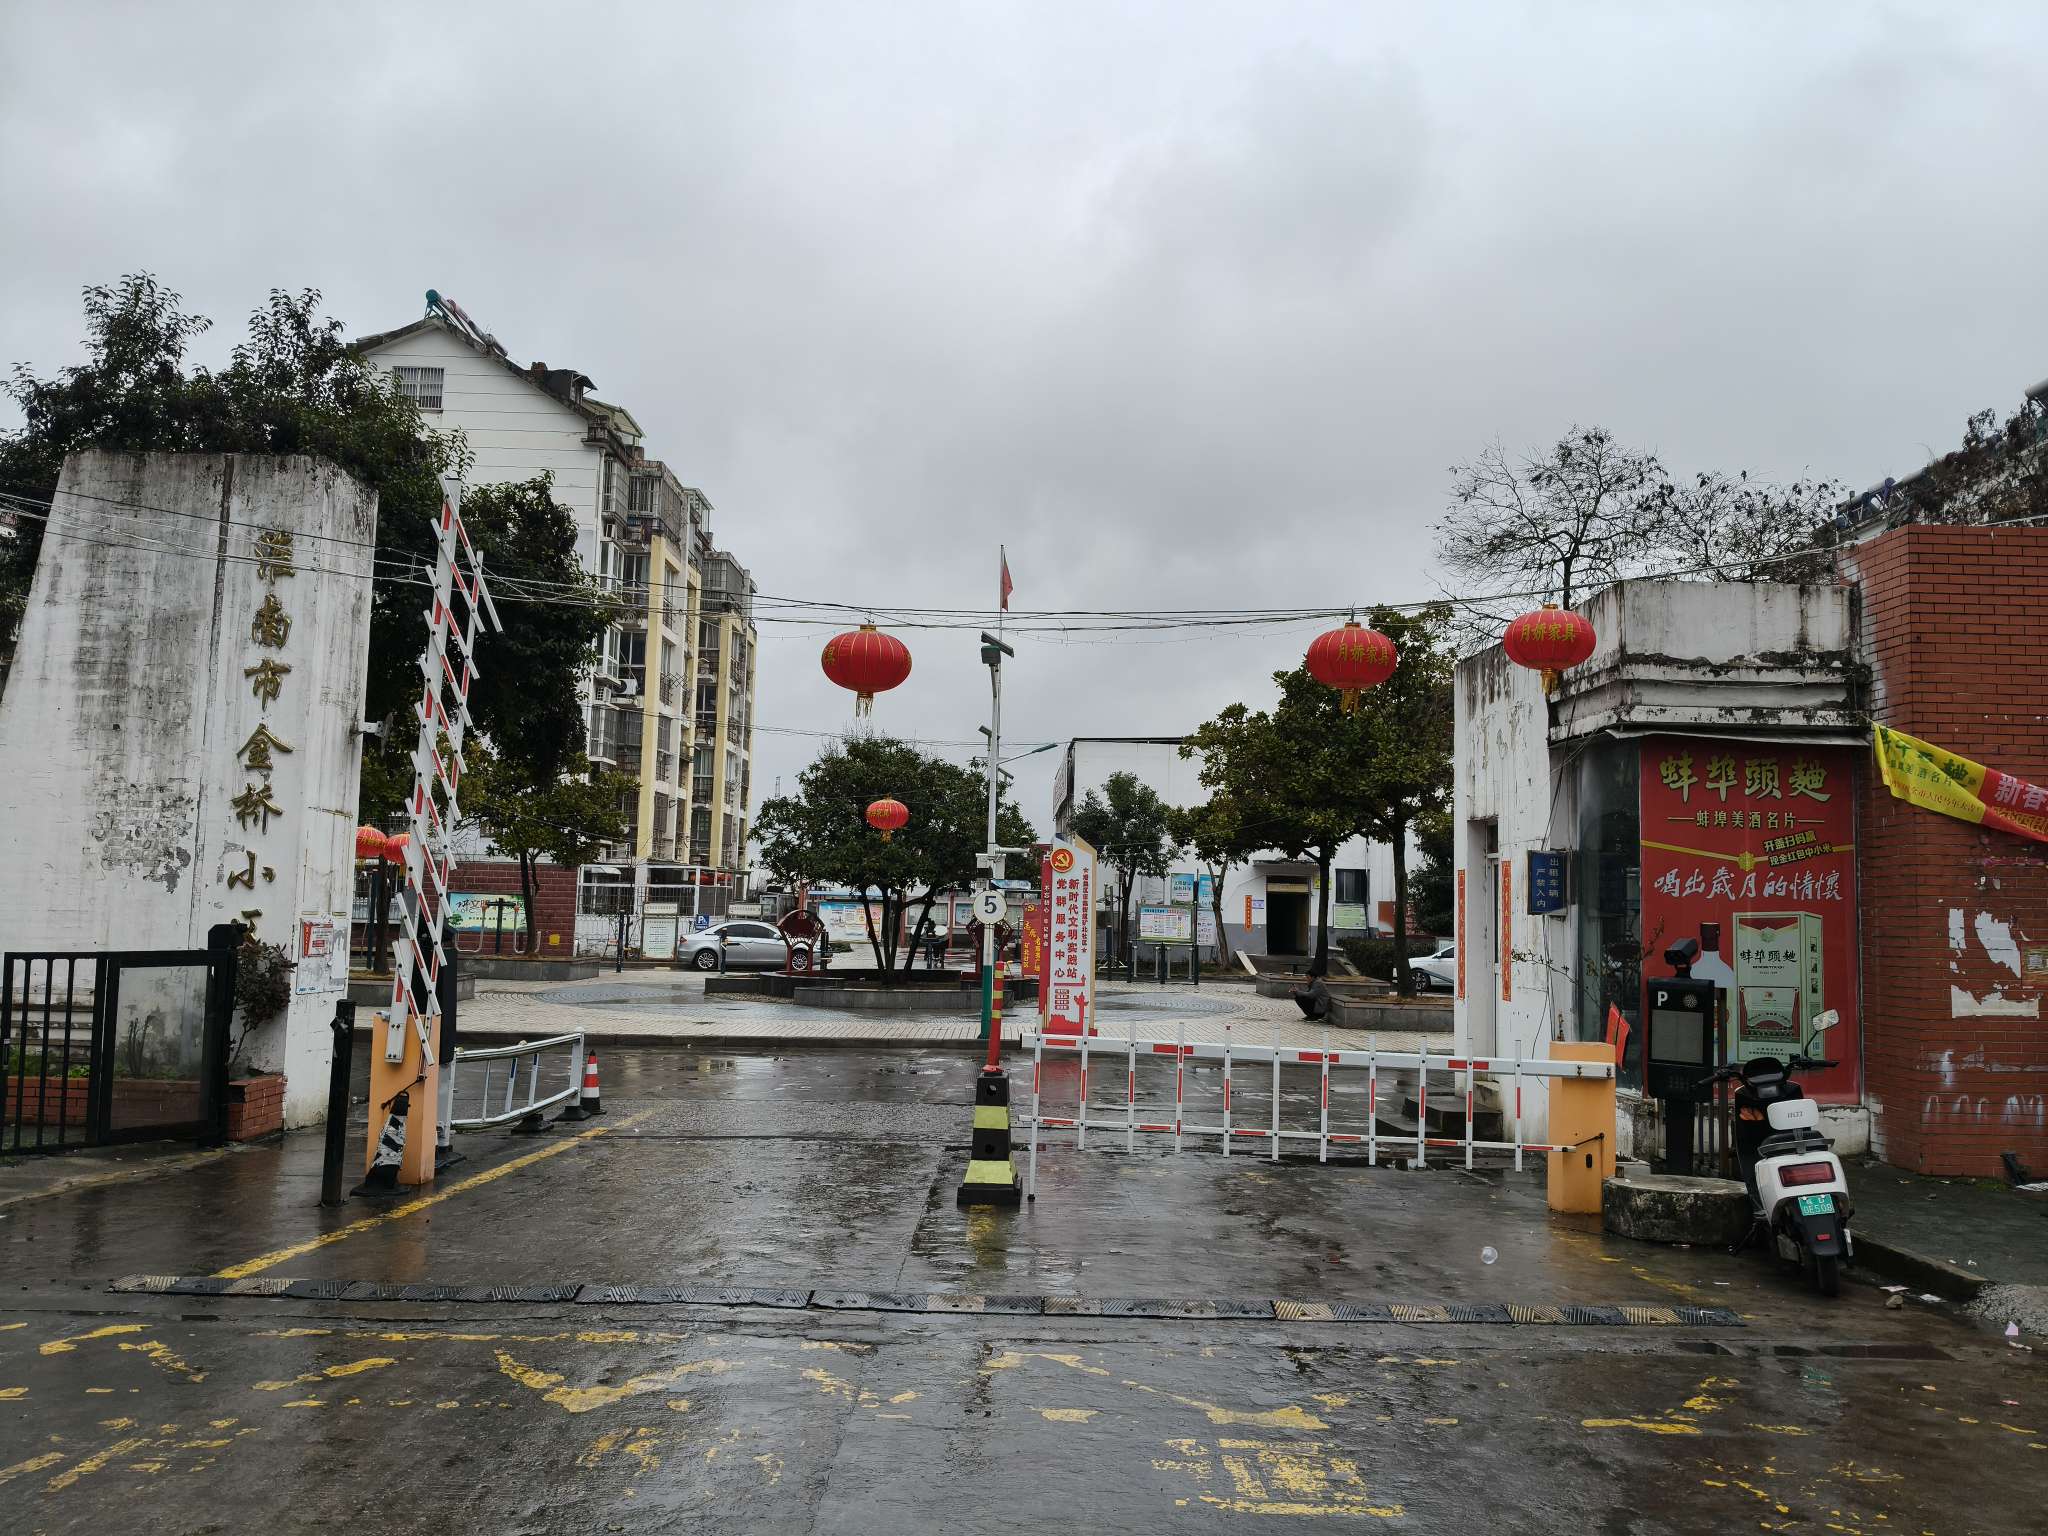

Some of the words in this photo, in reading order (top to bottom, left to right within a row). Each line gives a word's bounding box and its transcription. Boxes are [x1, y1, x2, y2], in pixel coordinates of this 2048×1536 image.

[1994, 773, 2048, 811] 新春
[1696, 810, 1797, 829] 蚌埠美酒名片
[984, 896, 998, 914] 5
[1536, 869, 1546, 907] 严禁入内
[1055, 878, 1067, 978] 党群服务中心
[1067, 878, 1079, 978] 新时代文明实践站
[1657, 991, 1668, 1006] P
